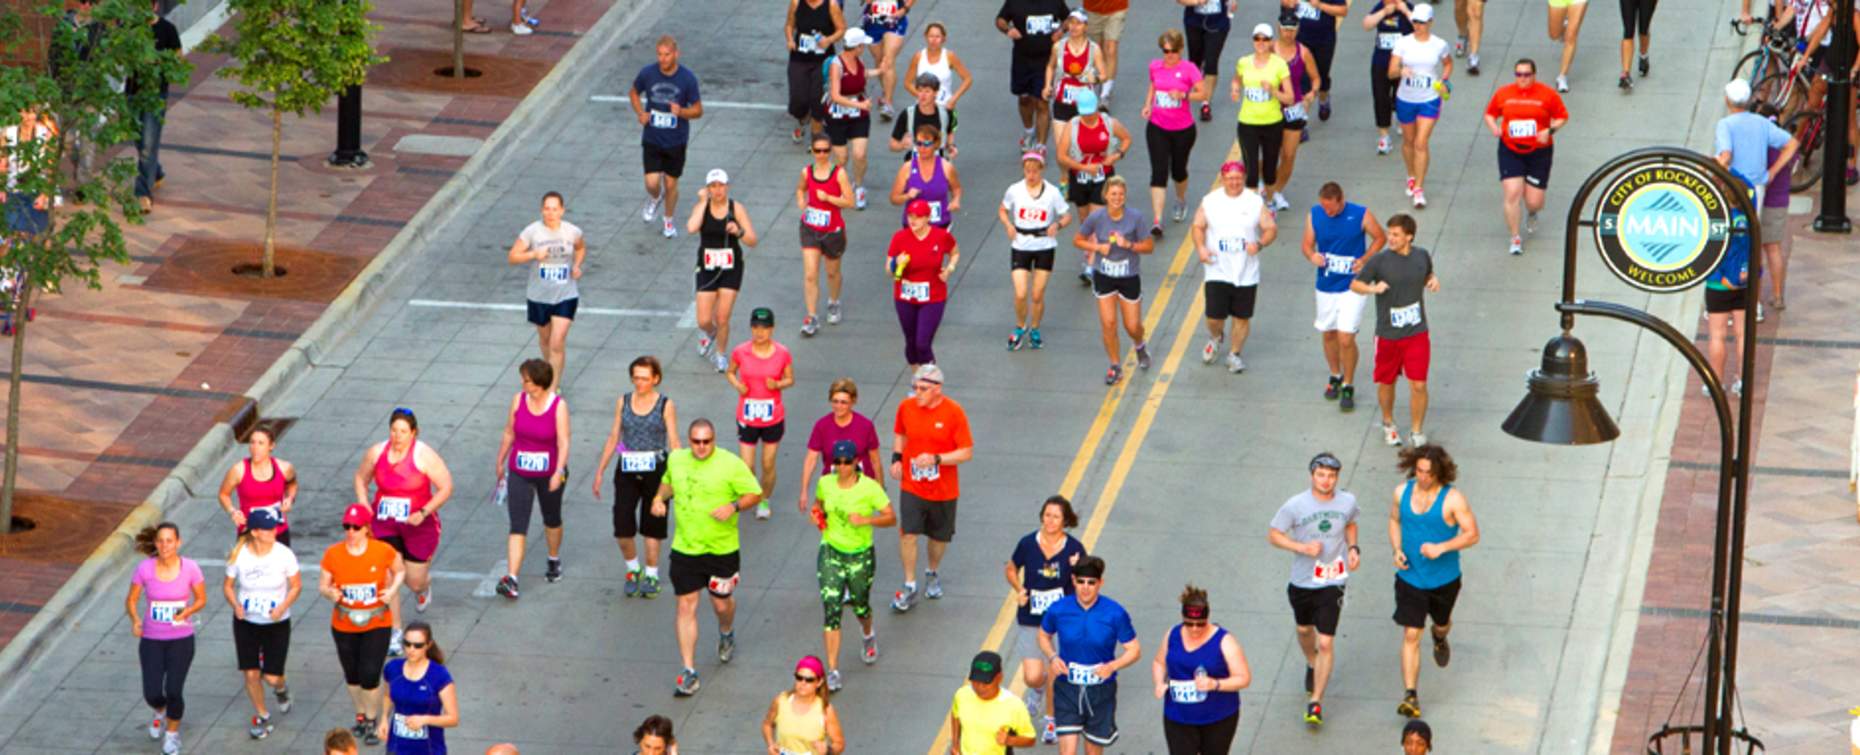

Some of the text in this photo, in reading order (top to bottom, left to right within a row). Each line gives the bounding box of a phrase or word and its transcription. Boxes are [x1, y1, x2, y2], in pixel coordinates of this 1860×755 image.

[1611, 170, 1717, 209] CITY OF ROCKFORD
[1627, 214, 1699, 237] MAIN
[1711, 223, 1725, 235] ST
[1628, 264, 1696, 284] WELCOME
[521, 455, 544, 471] 1270
